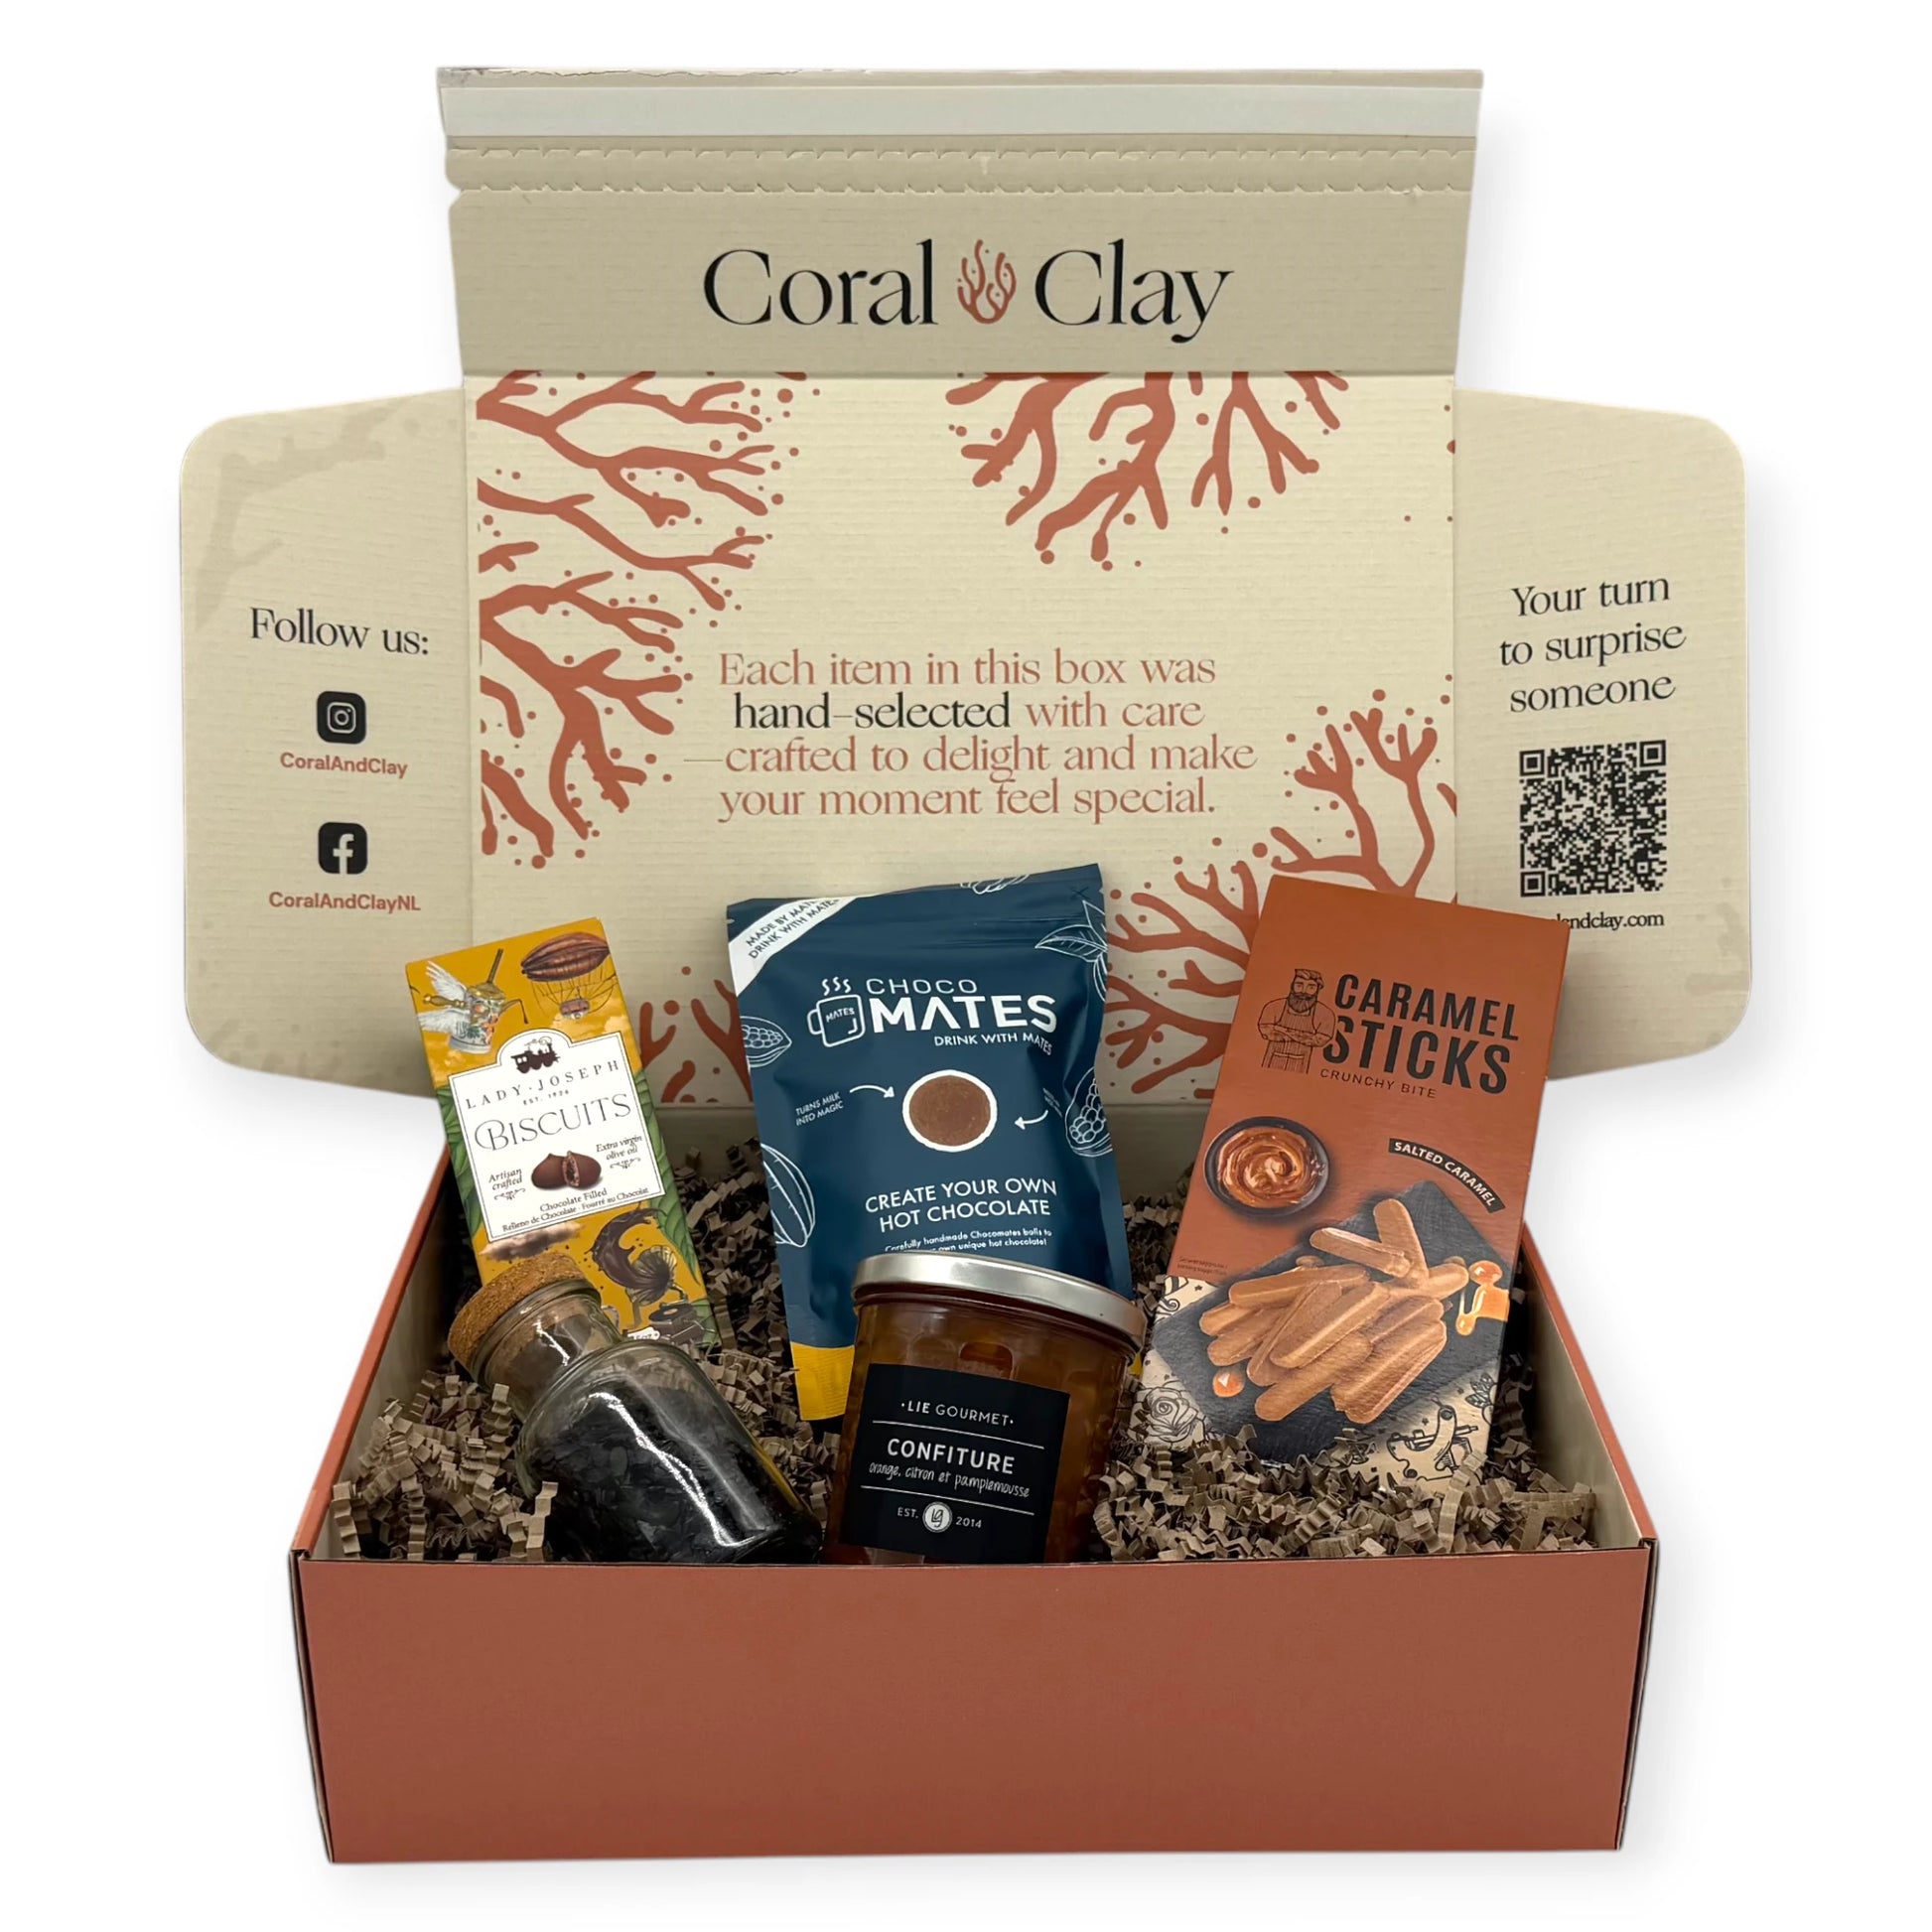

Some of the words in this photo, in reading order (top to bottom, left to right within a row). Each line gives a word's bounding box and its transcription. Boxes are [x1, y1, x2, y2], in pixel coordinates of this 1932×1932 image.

[704, 237, 939, 326] Coral
[1035, 237, 1234, 345] Clay
[1511, 585, 1587, 617] Your
[1598, 578, 1670, 608] turn
[250, 607, 370, 648] Follow
[382, 628, 429, 655] us:
[1499, 639, 1533, 666] to
[1545, 622, 1687, 667] surprise
[718, 649, 814, 686] Each
[830, 651, 912, 686] item
[926, 651, 960, 685] in
[974, 648, 1039, 685] this
[1054, 647, 1128, 684] box
[1141, 656, 1216, 684] was
[1024, 691, 1107, 728] with
[1122, 699, 1204, 728] care
[1510, 676, 1676, 713] someone
[280, 752, 408, 779] CoralAndClay
[871, 741, 907, 772] to
[922, 733, 1050, 783] delight
[1063, 733, 1135, 770] and
[1150, 733, 1259, 770] make
[718, 788, 805, 824] your
[819, 784, 983, 815] moment
[996, 777, 1059, 814] feel
[1073, 776, 1215, 825] special.
[268, 892, 421, 914] CoralAndClayNL
[746, 922, 777, 947] MADE
[774, 914, 789, 925] BY
[748, 931, 782, 959] DRINK
[779, 916, 808, 933] WITH
[866, 978, 978, 995] CHOCO
[826, 1007, 856, 1023] MATES
[869, 994, 1057, 1034] MATES
[1333, 974, 1520, 1041] CARAMEL
[934, 1034, 979, 1046] DRINK
[982, 1032, 1018, 1043] WITH
[1023, 1032, 1052, 1055] MATES
[1322, 1015, 1511, 1095] STICKS
[1319, 1067, 1396, 1091] CRUNCHY
[1400, 1082, 1437, 1100] BITE
[795, 1099, 821, 1116] TURNS
[822, 1091, 841, 1105] MILK
[796, 1112, 816, 1126] INTO
[817, 1100, 844, 1118] MAGIC
[474, 1093, 631, 1152] BISCUITS
[596, 1142, 619, 1152] Extra
[607, 1151, 624, 1160] olive
[488, 1169, 522, 1183] Artisan
[491, 1176, 523, 1191] crafted
[1394, 1141, 1444, 1166] SALTED
[1445, 1160, 1496, 1207] CARAMEL
[539, 1194, 582, 1212] Chocolate
[583, 1187, 608, 1202] Filled
[865, 1188, 936, 1213] CREATE
[941, 1178, 999, 1197] YOUR
[1005, 1177, 1057, 1196] OWN
[540, 1206, 576, 1221] Chocolate
[880, 1208, 925, 1233] HOT
[926, 1199, 1051, 1222] CHOCOLATE
[885, 1239, 921, 1252] Carefully
[923, 1231, 968, 1245] handmade
[970, 1229, 1022, 1238] Chocomates
[1023, 1227, 1042, 1236] balls
[958, 1242, 987, 1251] unique
[887, 1438, 1016, 1474] CONFITURE
[869, 1461, 901, 1480] orange,
[904, 1466, 935, 1481] citron
[938, 1471, 951, 1483] et
[954, 1473, 1031, 1498] pamplemousse
[897, 1506, 919, 1519] EST.
[955, 1515, 983, 1529] 2014
